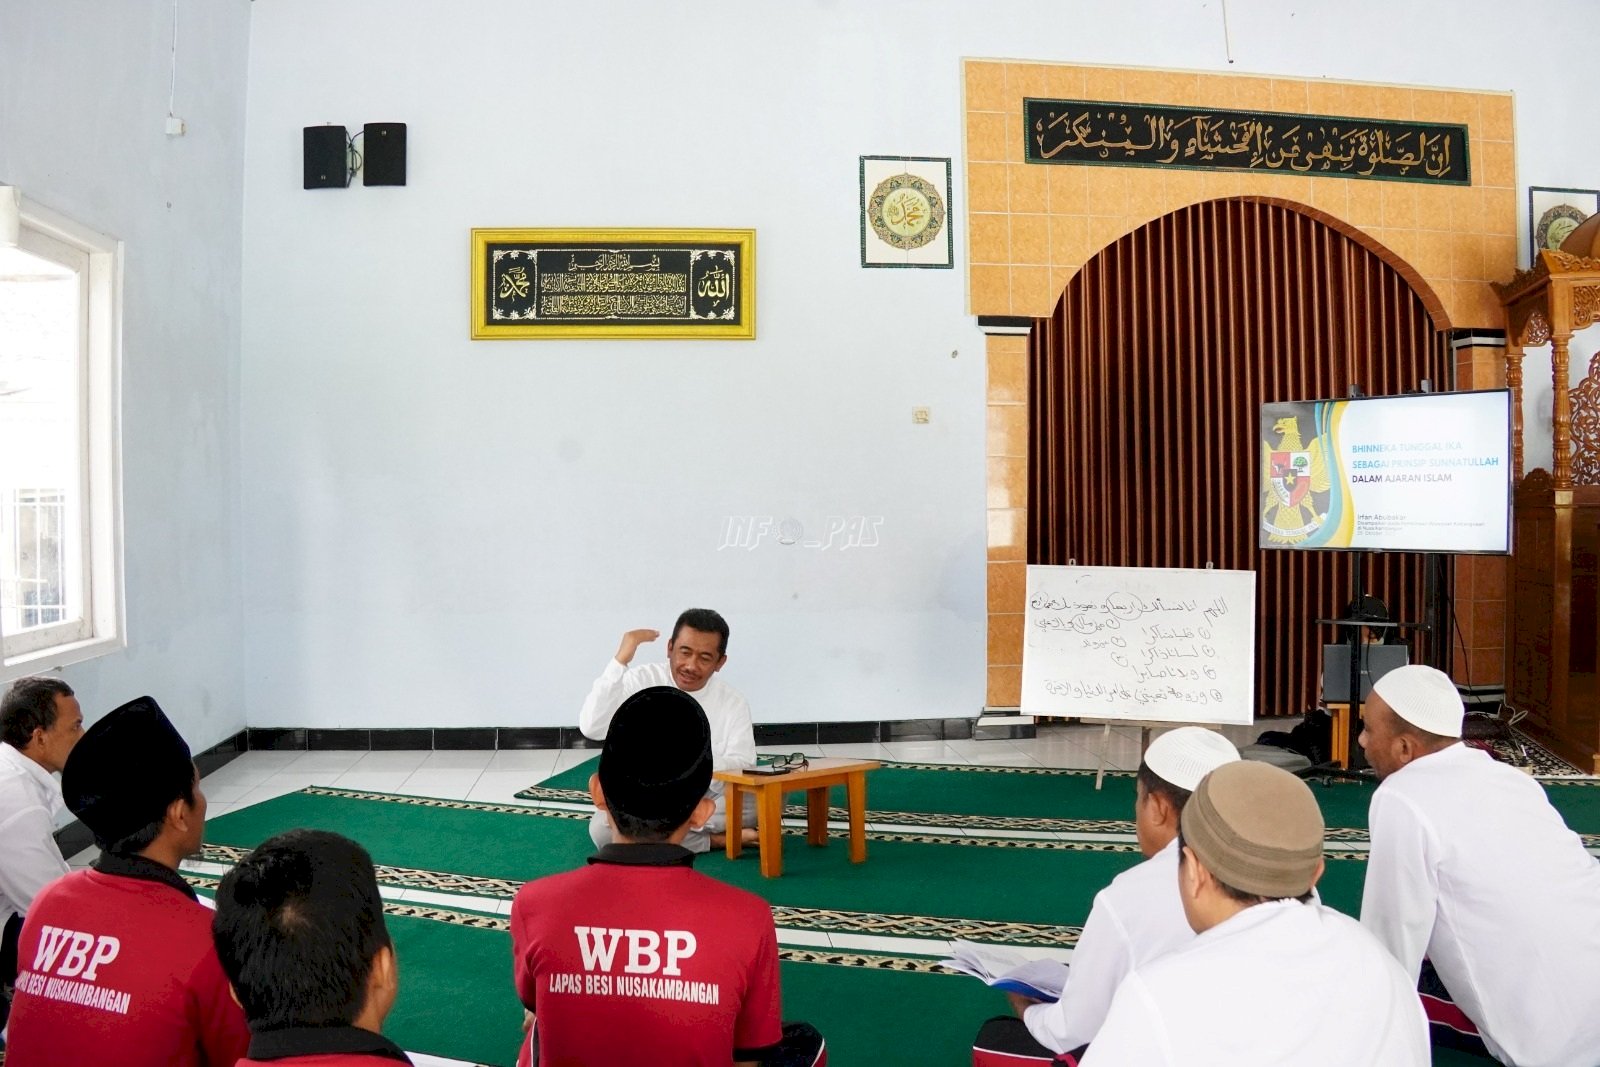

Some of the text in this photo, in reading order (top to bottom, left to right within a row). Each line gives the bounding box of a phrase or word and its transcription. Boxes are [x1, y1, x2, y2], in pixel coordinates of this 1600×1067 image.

[1352, 441, 1463, 453] BHINNEKA TUNGGAL IKA
[1352, 456, 1499, 469] SEBAGAI PRINSIP SUNNATULLAH
[1352, 473, 1452, 483] DALAM AJARAN ISLAM
[1357, 513, 1372, 521] Irfan
[33, 925, 121, 982] WBP
[574, 926, 698, 977] WBP
[26, 973, 47, 996] BESI
[44, 976, 132, 1015] NUSAKAMBANGAN
[550, 973, 720, 1006] LAPAS BESI NUSAKAMBANGAN
